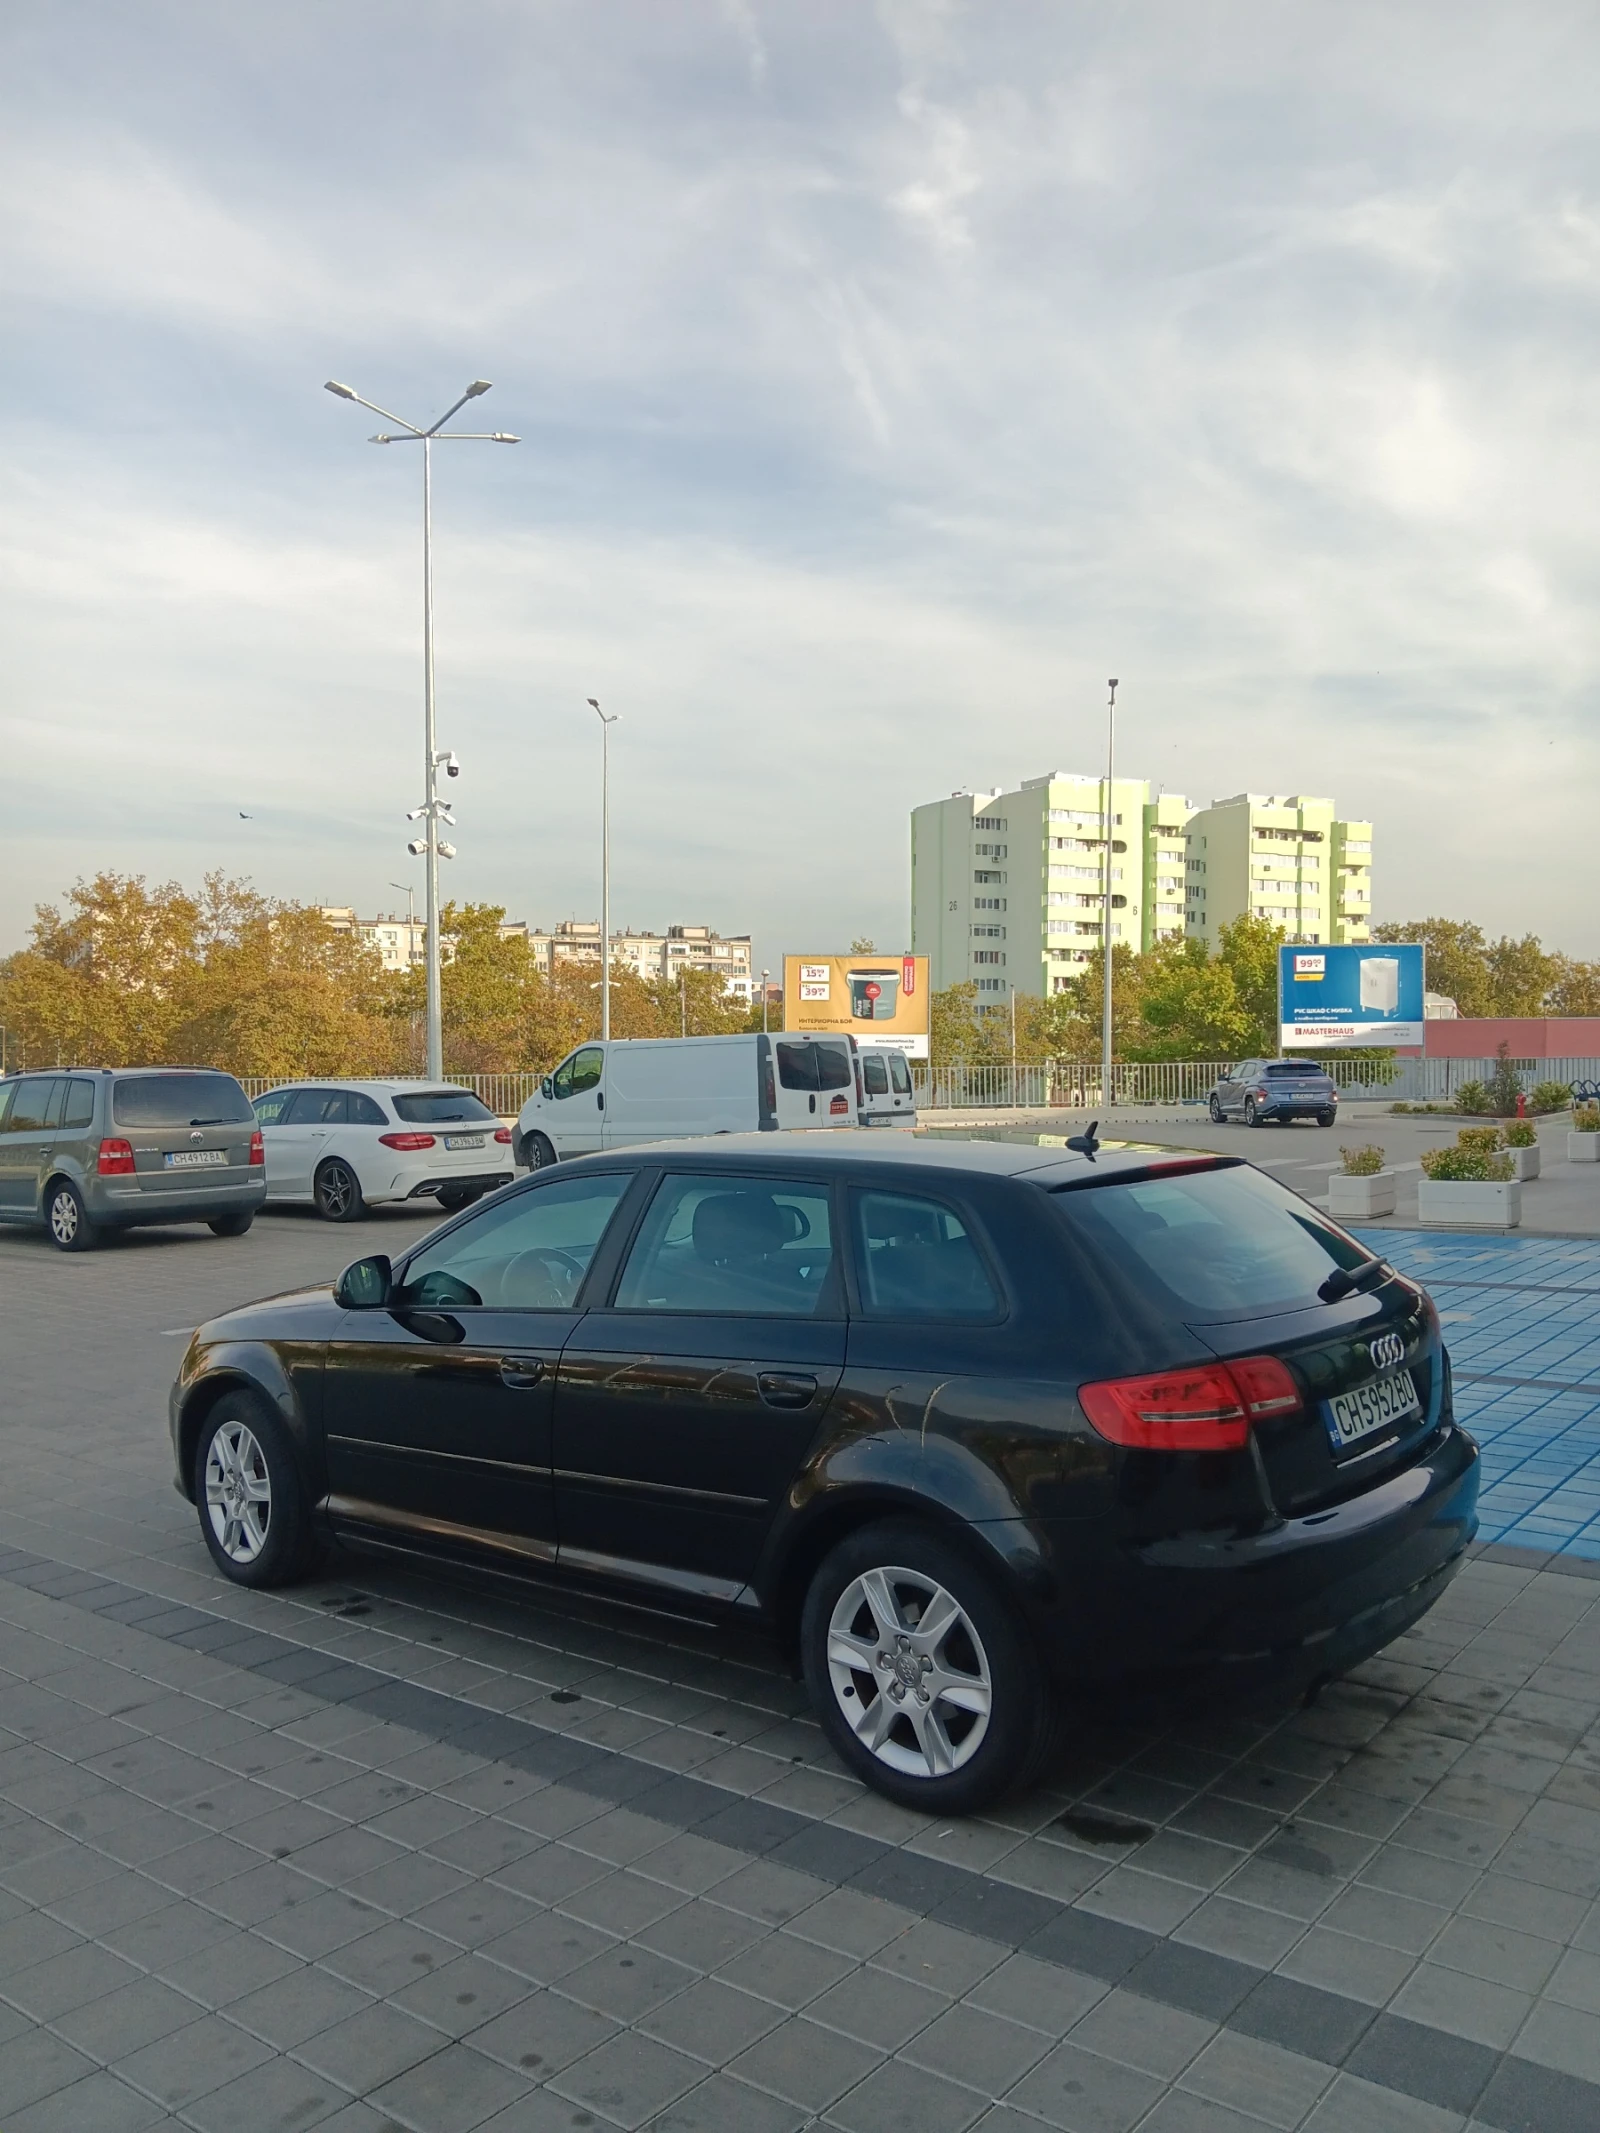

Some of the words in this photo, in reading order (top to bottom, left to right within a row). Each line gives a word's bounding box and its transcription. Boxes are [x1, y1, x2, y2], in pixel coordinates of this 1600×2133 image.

[948, 901, 958, 911] 26
[1303, 1027, 1355, 1035] MASTERHAUS
[1329, 1429, 1340, 1442] BG
